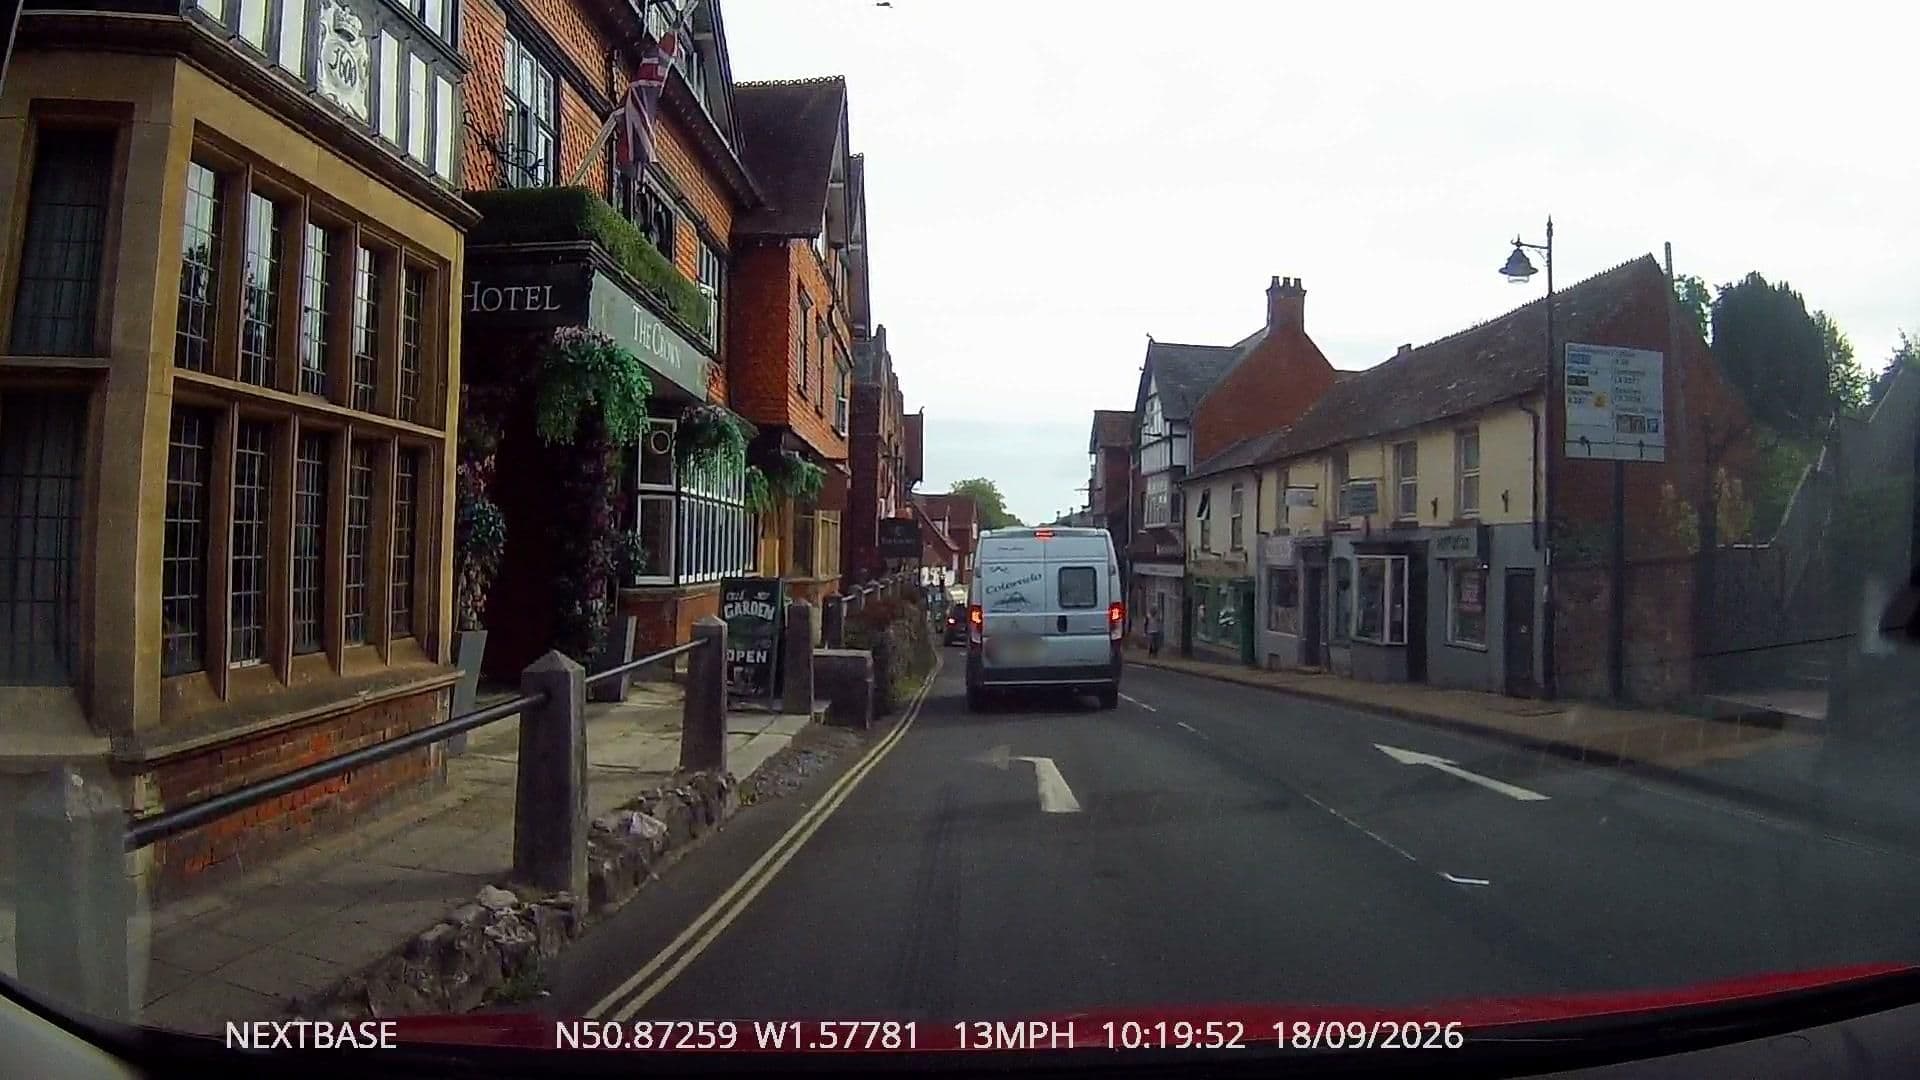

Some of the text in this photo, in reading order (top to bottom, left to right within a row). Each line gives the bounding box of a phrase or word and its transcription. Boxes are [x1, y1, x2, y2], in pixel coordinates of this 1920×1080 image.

[632, 304, 652, 350] THE
[724, 600, 775, 620] GARDEN
[726, 648, 768, 663] OPEN
